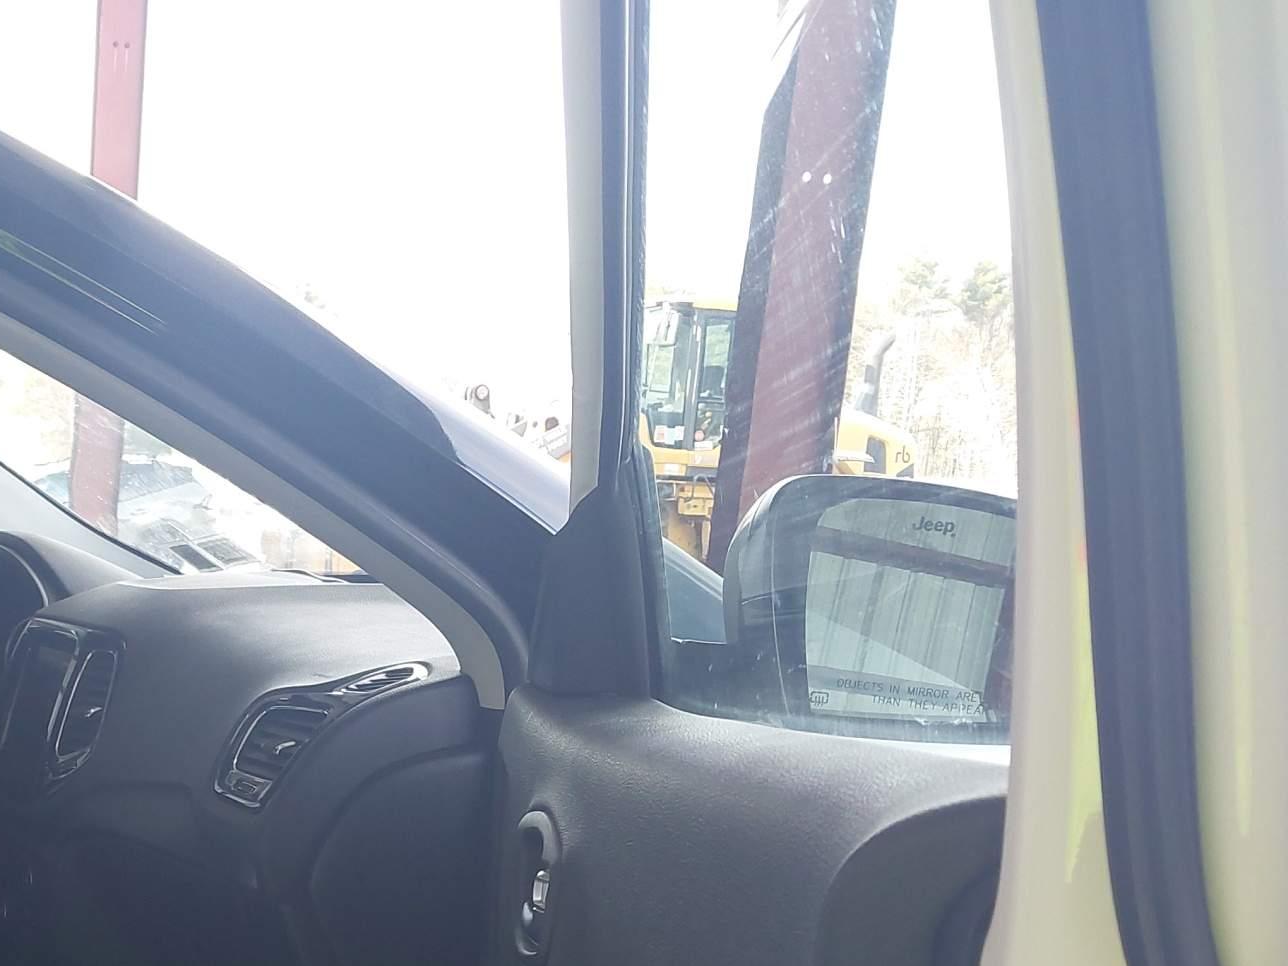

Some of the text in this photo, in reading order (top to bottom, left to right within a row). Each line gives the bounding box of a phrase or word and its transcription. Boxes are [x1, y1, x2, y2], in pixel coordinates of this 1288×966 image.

[912, 516, 955, 535] Jeep
[837, 679, 977, 703] OBJECTS IN MIRROR ARE
[872, 695, 901, 707] THAN
[909, 698, 938, 711] THEY
